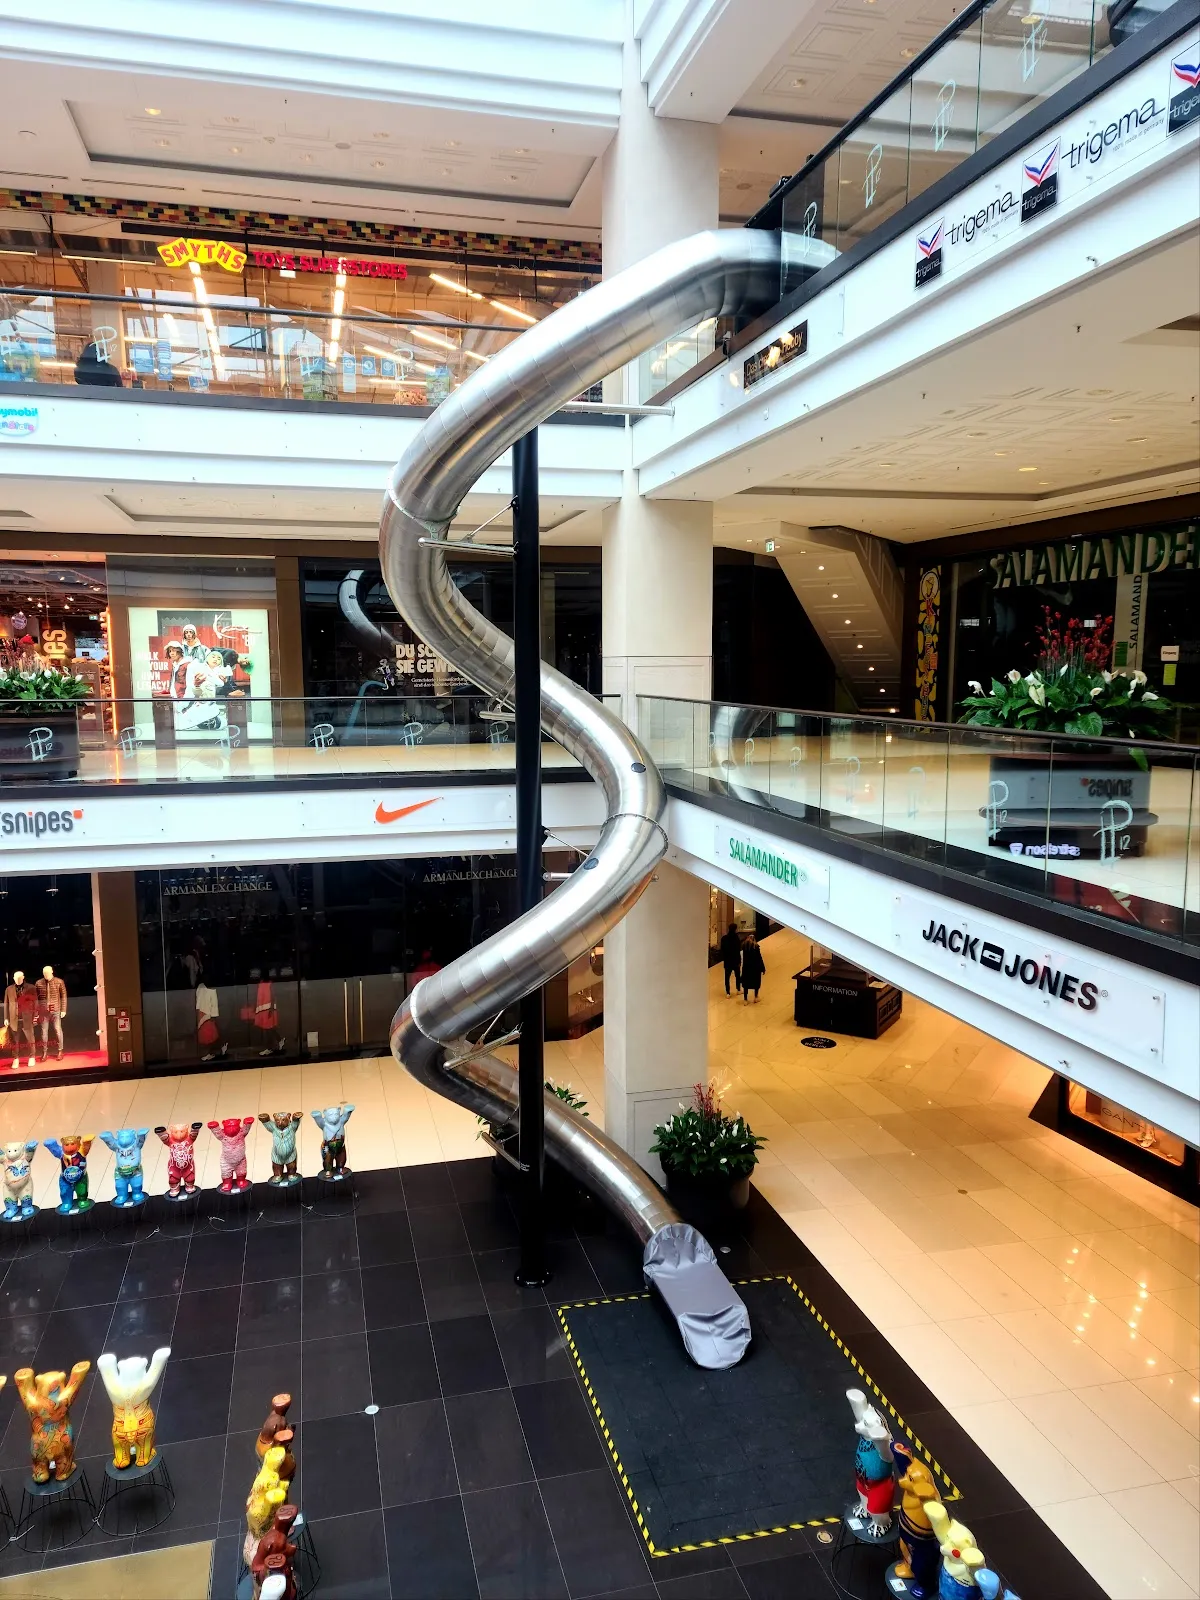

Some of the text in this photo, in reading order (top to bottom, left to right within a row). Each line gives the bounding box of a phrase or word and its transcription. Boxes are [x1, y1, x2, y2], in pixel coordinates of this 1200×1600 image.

[1061, 98, 1166, 169] trigema
[1021, 185, 1057, 211] trigema
[945, 192, 1020, 245] trigema
[160, 241, 245, 270] SMYTHS
[253, 251, 408, 279] TOYS SUPERSTORES
[915, 258, 942, 278] trigema
[1129, 574, 1142, 649] SALAMAND
[395, 643, 415, 659] DU
[148, 661, 169, 671] YOUR
[395, 659, 457, 674] SIE GEWI
[1, 810, 74, 838] snipes
[729, 837, 798, 888] SALAMANDER
[163, 881, 272, 896] ARMANI EXCHANGE
[922, 920, 979, 962] JACK
[812, 984, 858, 997] INFORMATION
